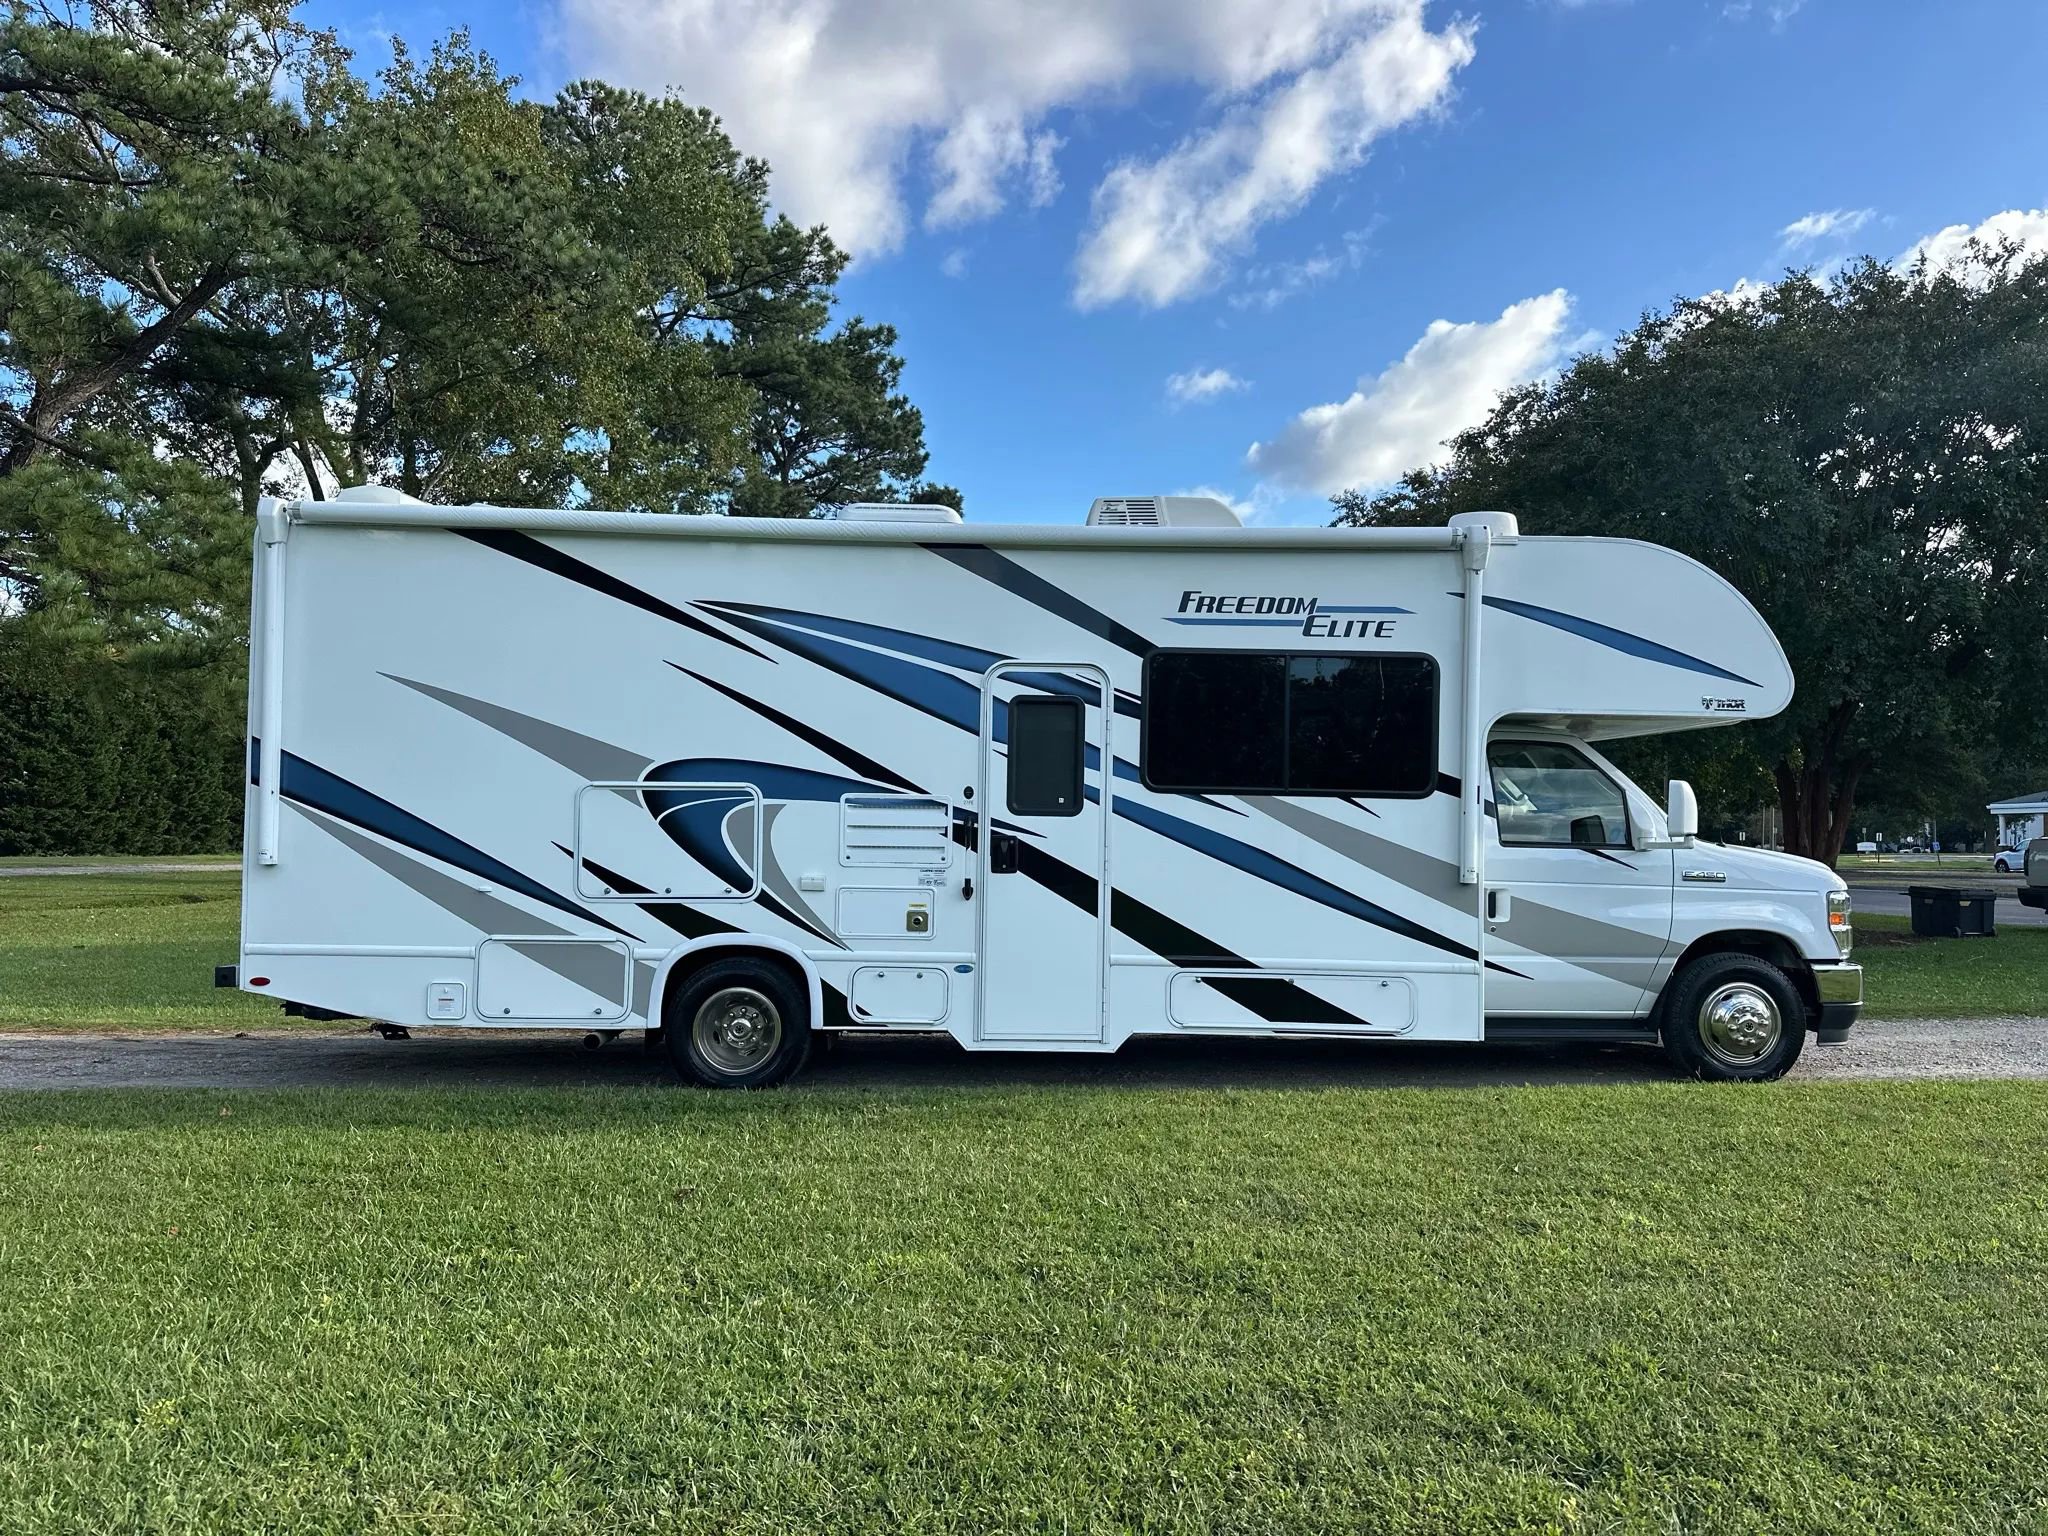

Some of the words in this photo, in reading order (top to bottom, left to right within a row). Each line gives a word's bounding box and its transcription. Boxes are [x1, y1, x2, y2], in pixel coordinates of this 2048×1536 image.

[1177, 590, 1319, 615] FREEDOM
[1302, 614, 1397, 638] ELITE
[1714, 698, 1745, 709] THOR
